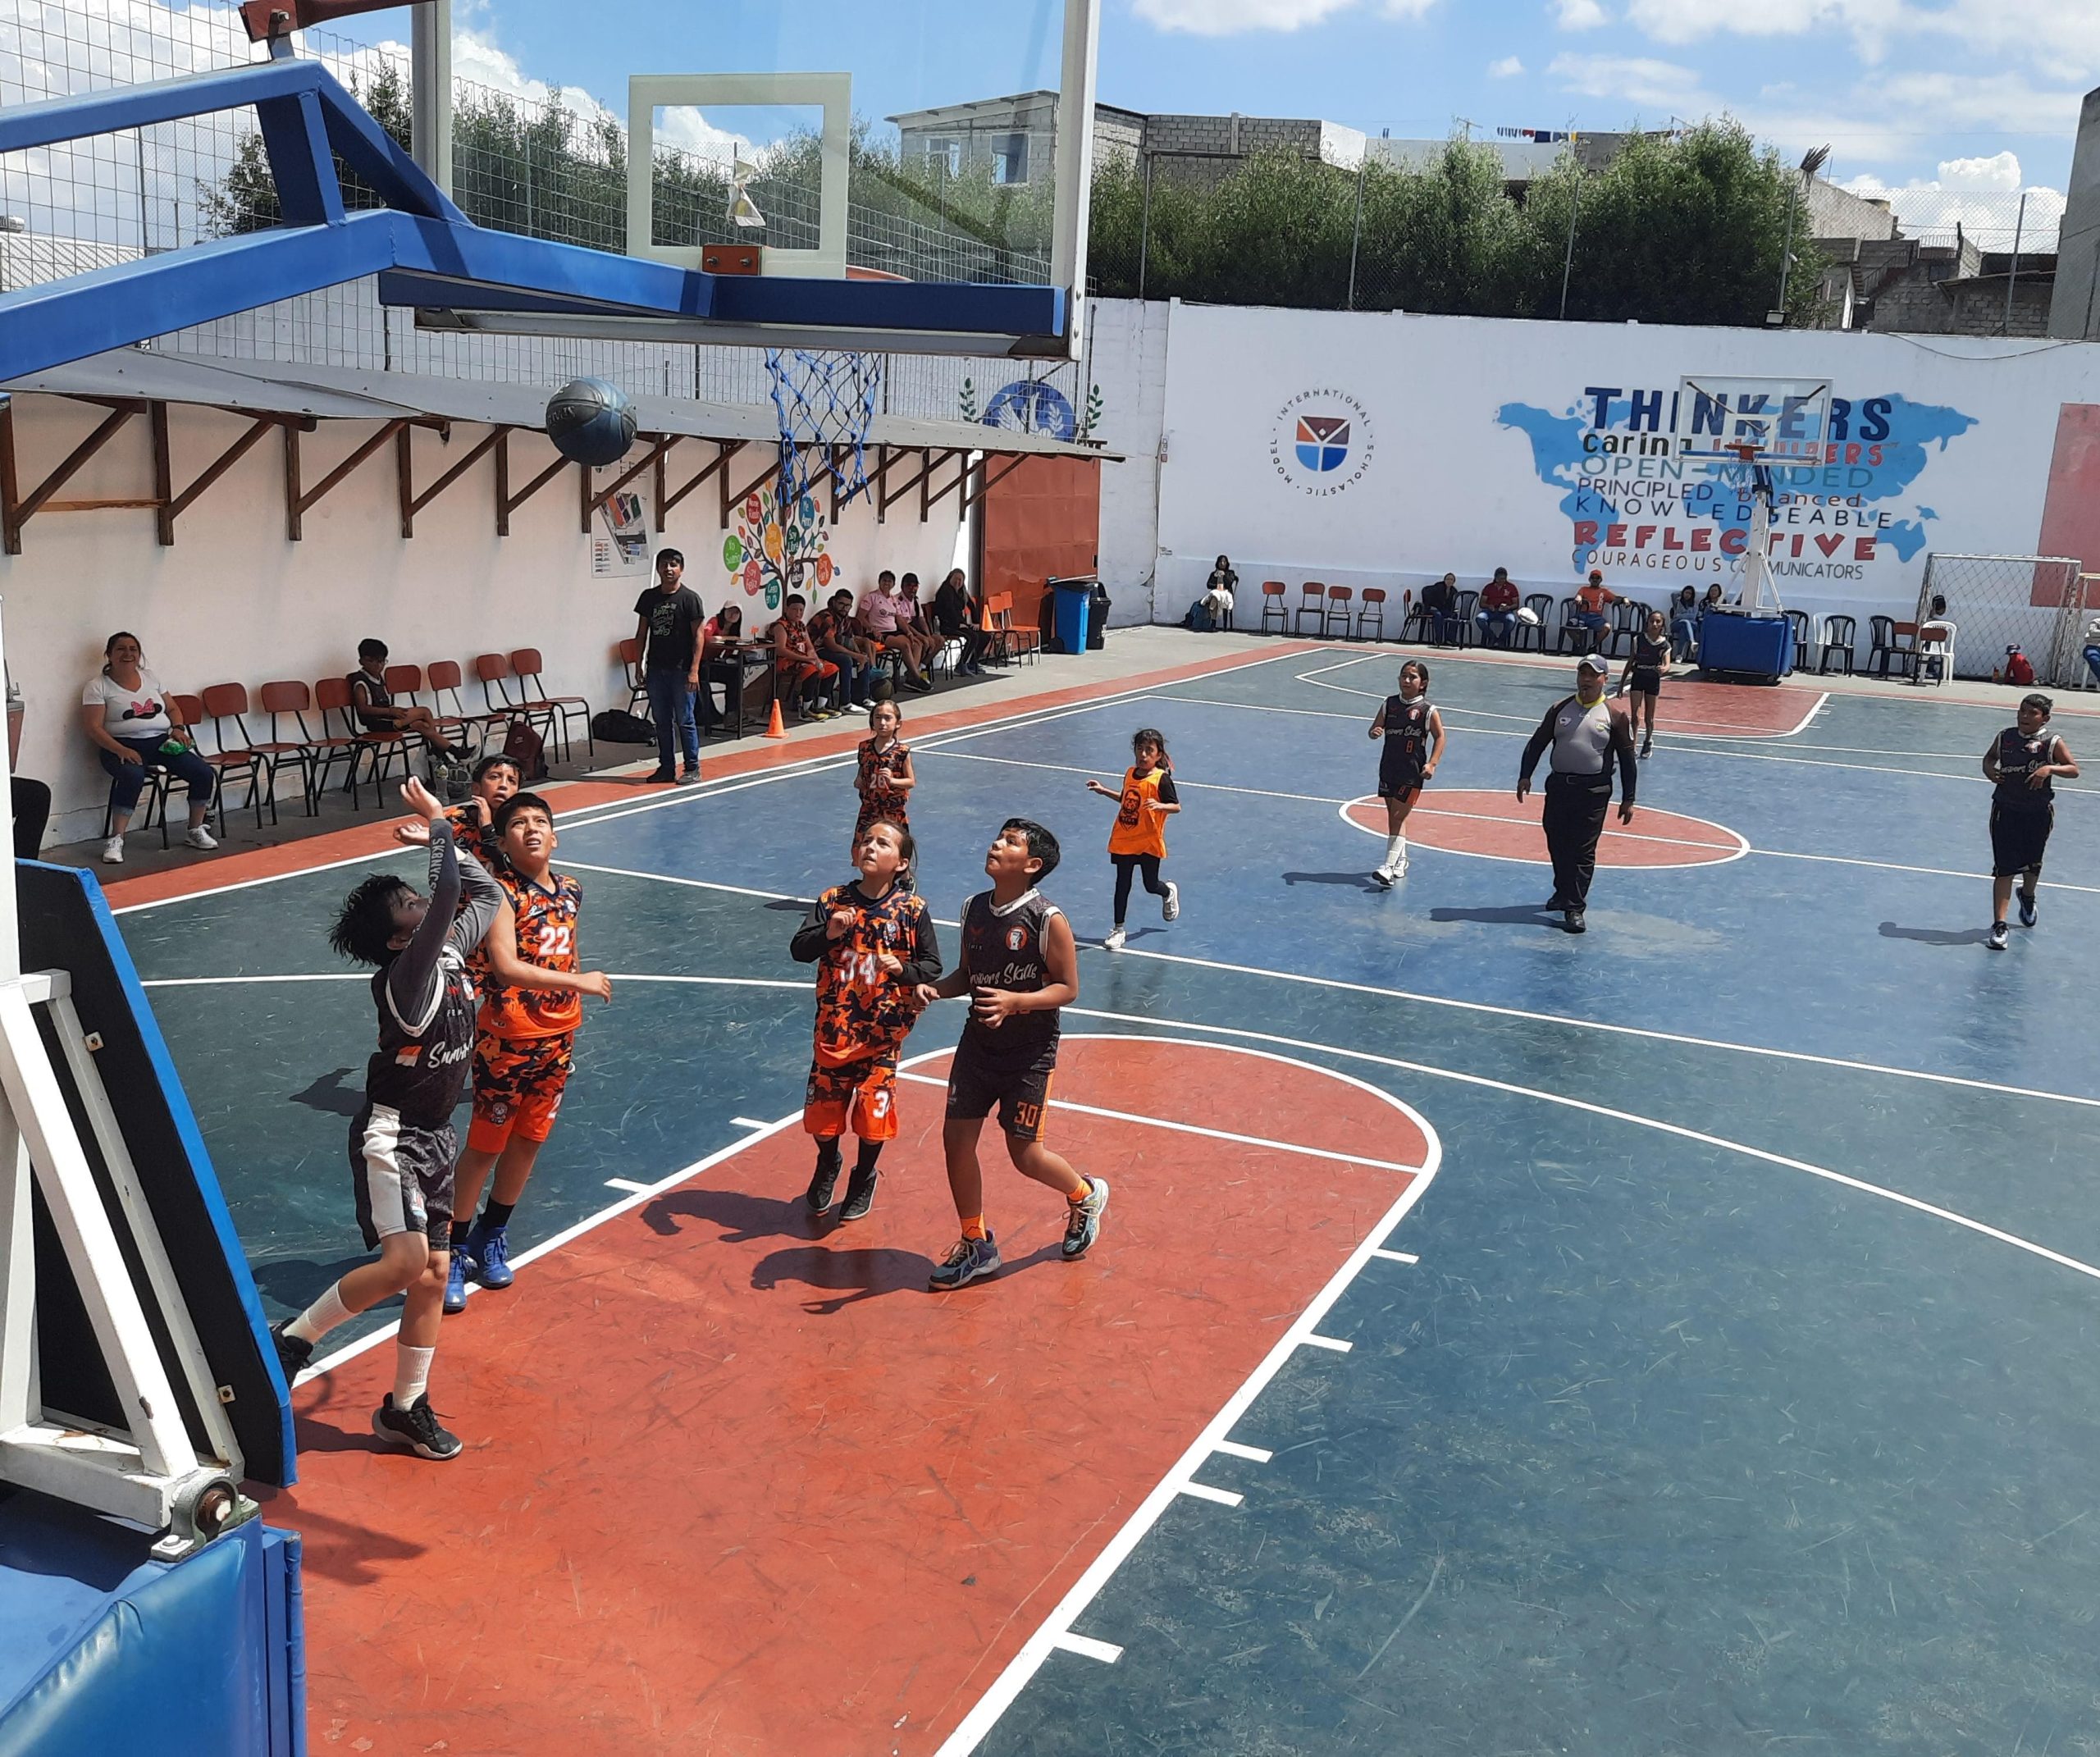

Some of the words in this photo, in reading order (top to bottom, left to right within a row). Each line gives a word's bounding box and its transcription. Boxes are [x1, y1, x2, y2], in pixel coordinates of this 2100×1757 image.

[1277, 389, 1371, 427] INTERNATIONAL
[1585, 387, 1892, 440] THINKERS
[1270, 439, 1294, 484] MODEL
[1306, 445, 1374, 496] SCHOLASTIC
[1577, 477, 1714, 500] PRINCIPLED
[1737, 487, 1863, 508] banced
[1576, 496, 1892, 529] KNOWLEDGEABLE
[1572, 549, 1721, 573] COURAGEOUS
[1730, 558, 1864, 580] COMUNICATORS
[538, 924, 570, 956] 22
[1003, 962, 1038, 984] Skills
[1014, 1101, 1039, 1129] 30
